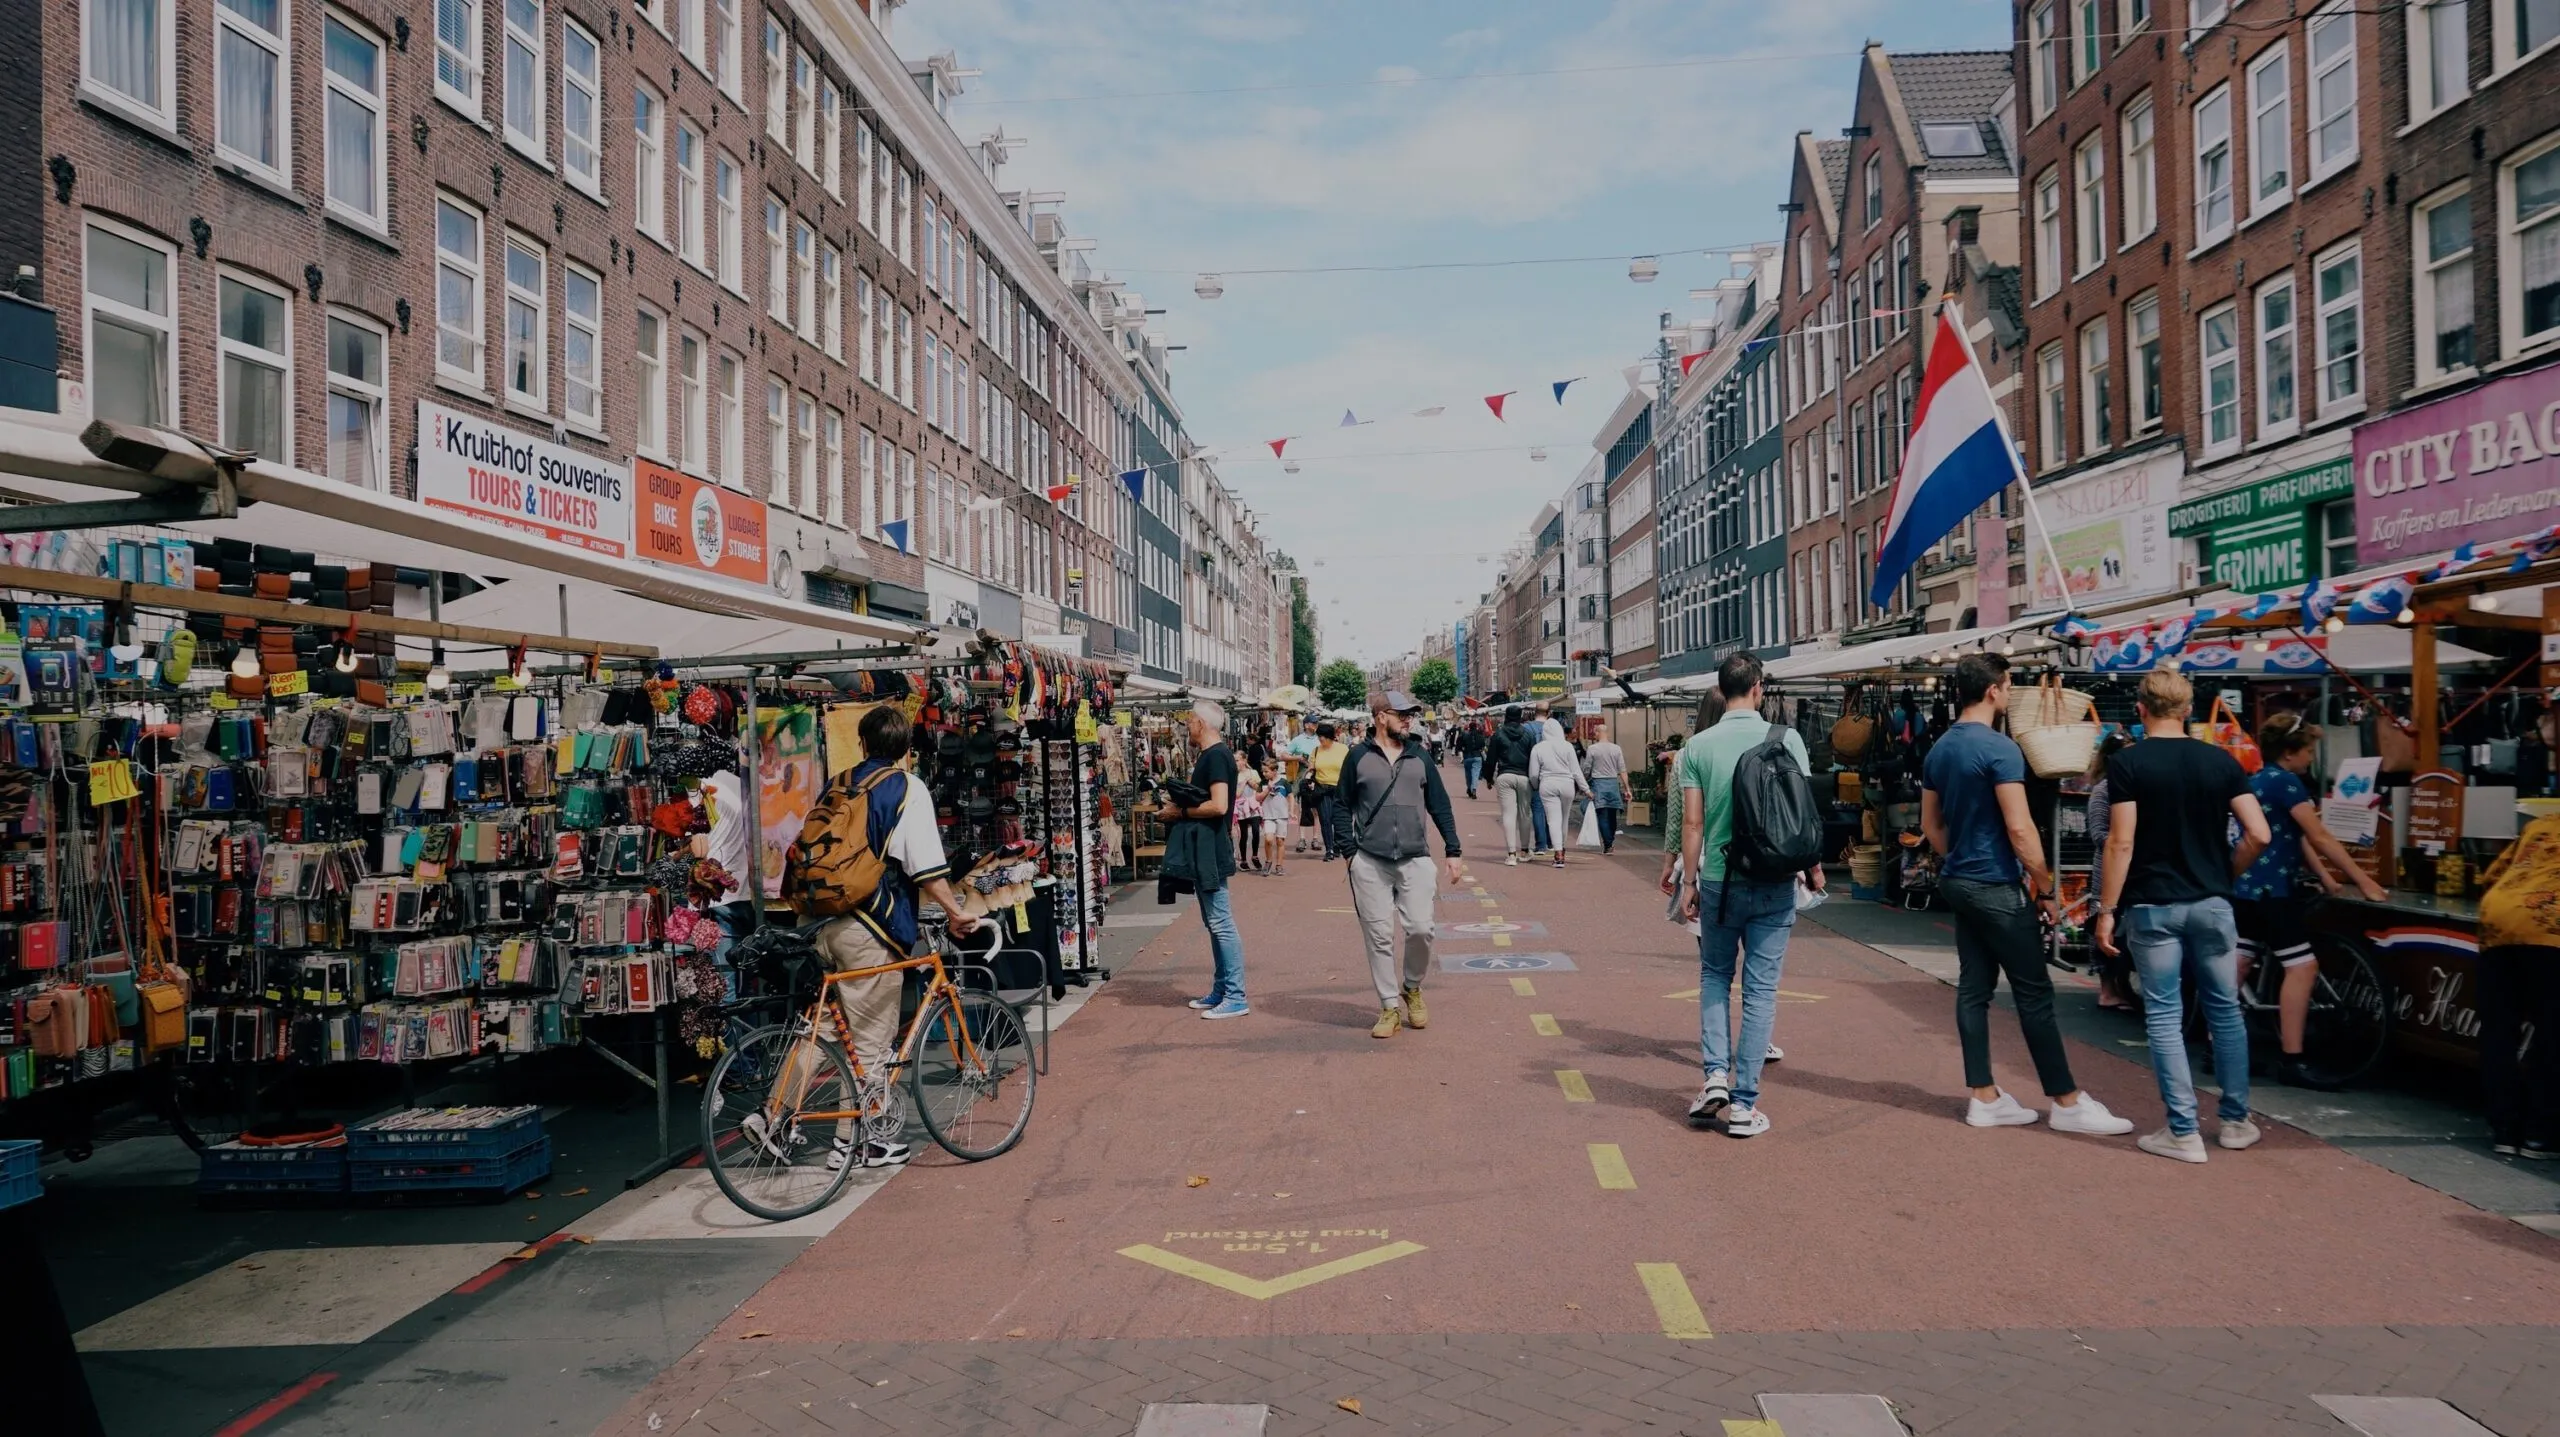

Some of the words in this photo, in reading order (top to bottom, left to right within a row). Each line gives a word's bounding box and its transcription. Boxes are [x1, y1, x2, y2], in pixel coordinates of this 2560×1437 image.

[447, 417, 533, 475] Kruithof
[539, 455, 621, 502] souvenirs
[2364, 429, 2461, 498] CITY
[468, 466, 521, 511] TOURS
[525, 483, 536, 515] &
[539, 487, 597, 530] TICKETS
[648, 474, 682, 500] GROUP
[654, 502, 678, 528] BIKE
[728, 514, 761, 538] LUGGAGE
[2169, 491, 2252, 530] DROGISTERIJ
[2369, 508, 2436, 551] Koffers
[2437, 508, 2460, 529] en
[650, 529, 682, 555] TOURS
[728, 539, 761, 562] STORAGE
[2214, 538, 2304, 592] GRIMME
